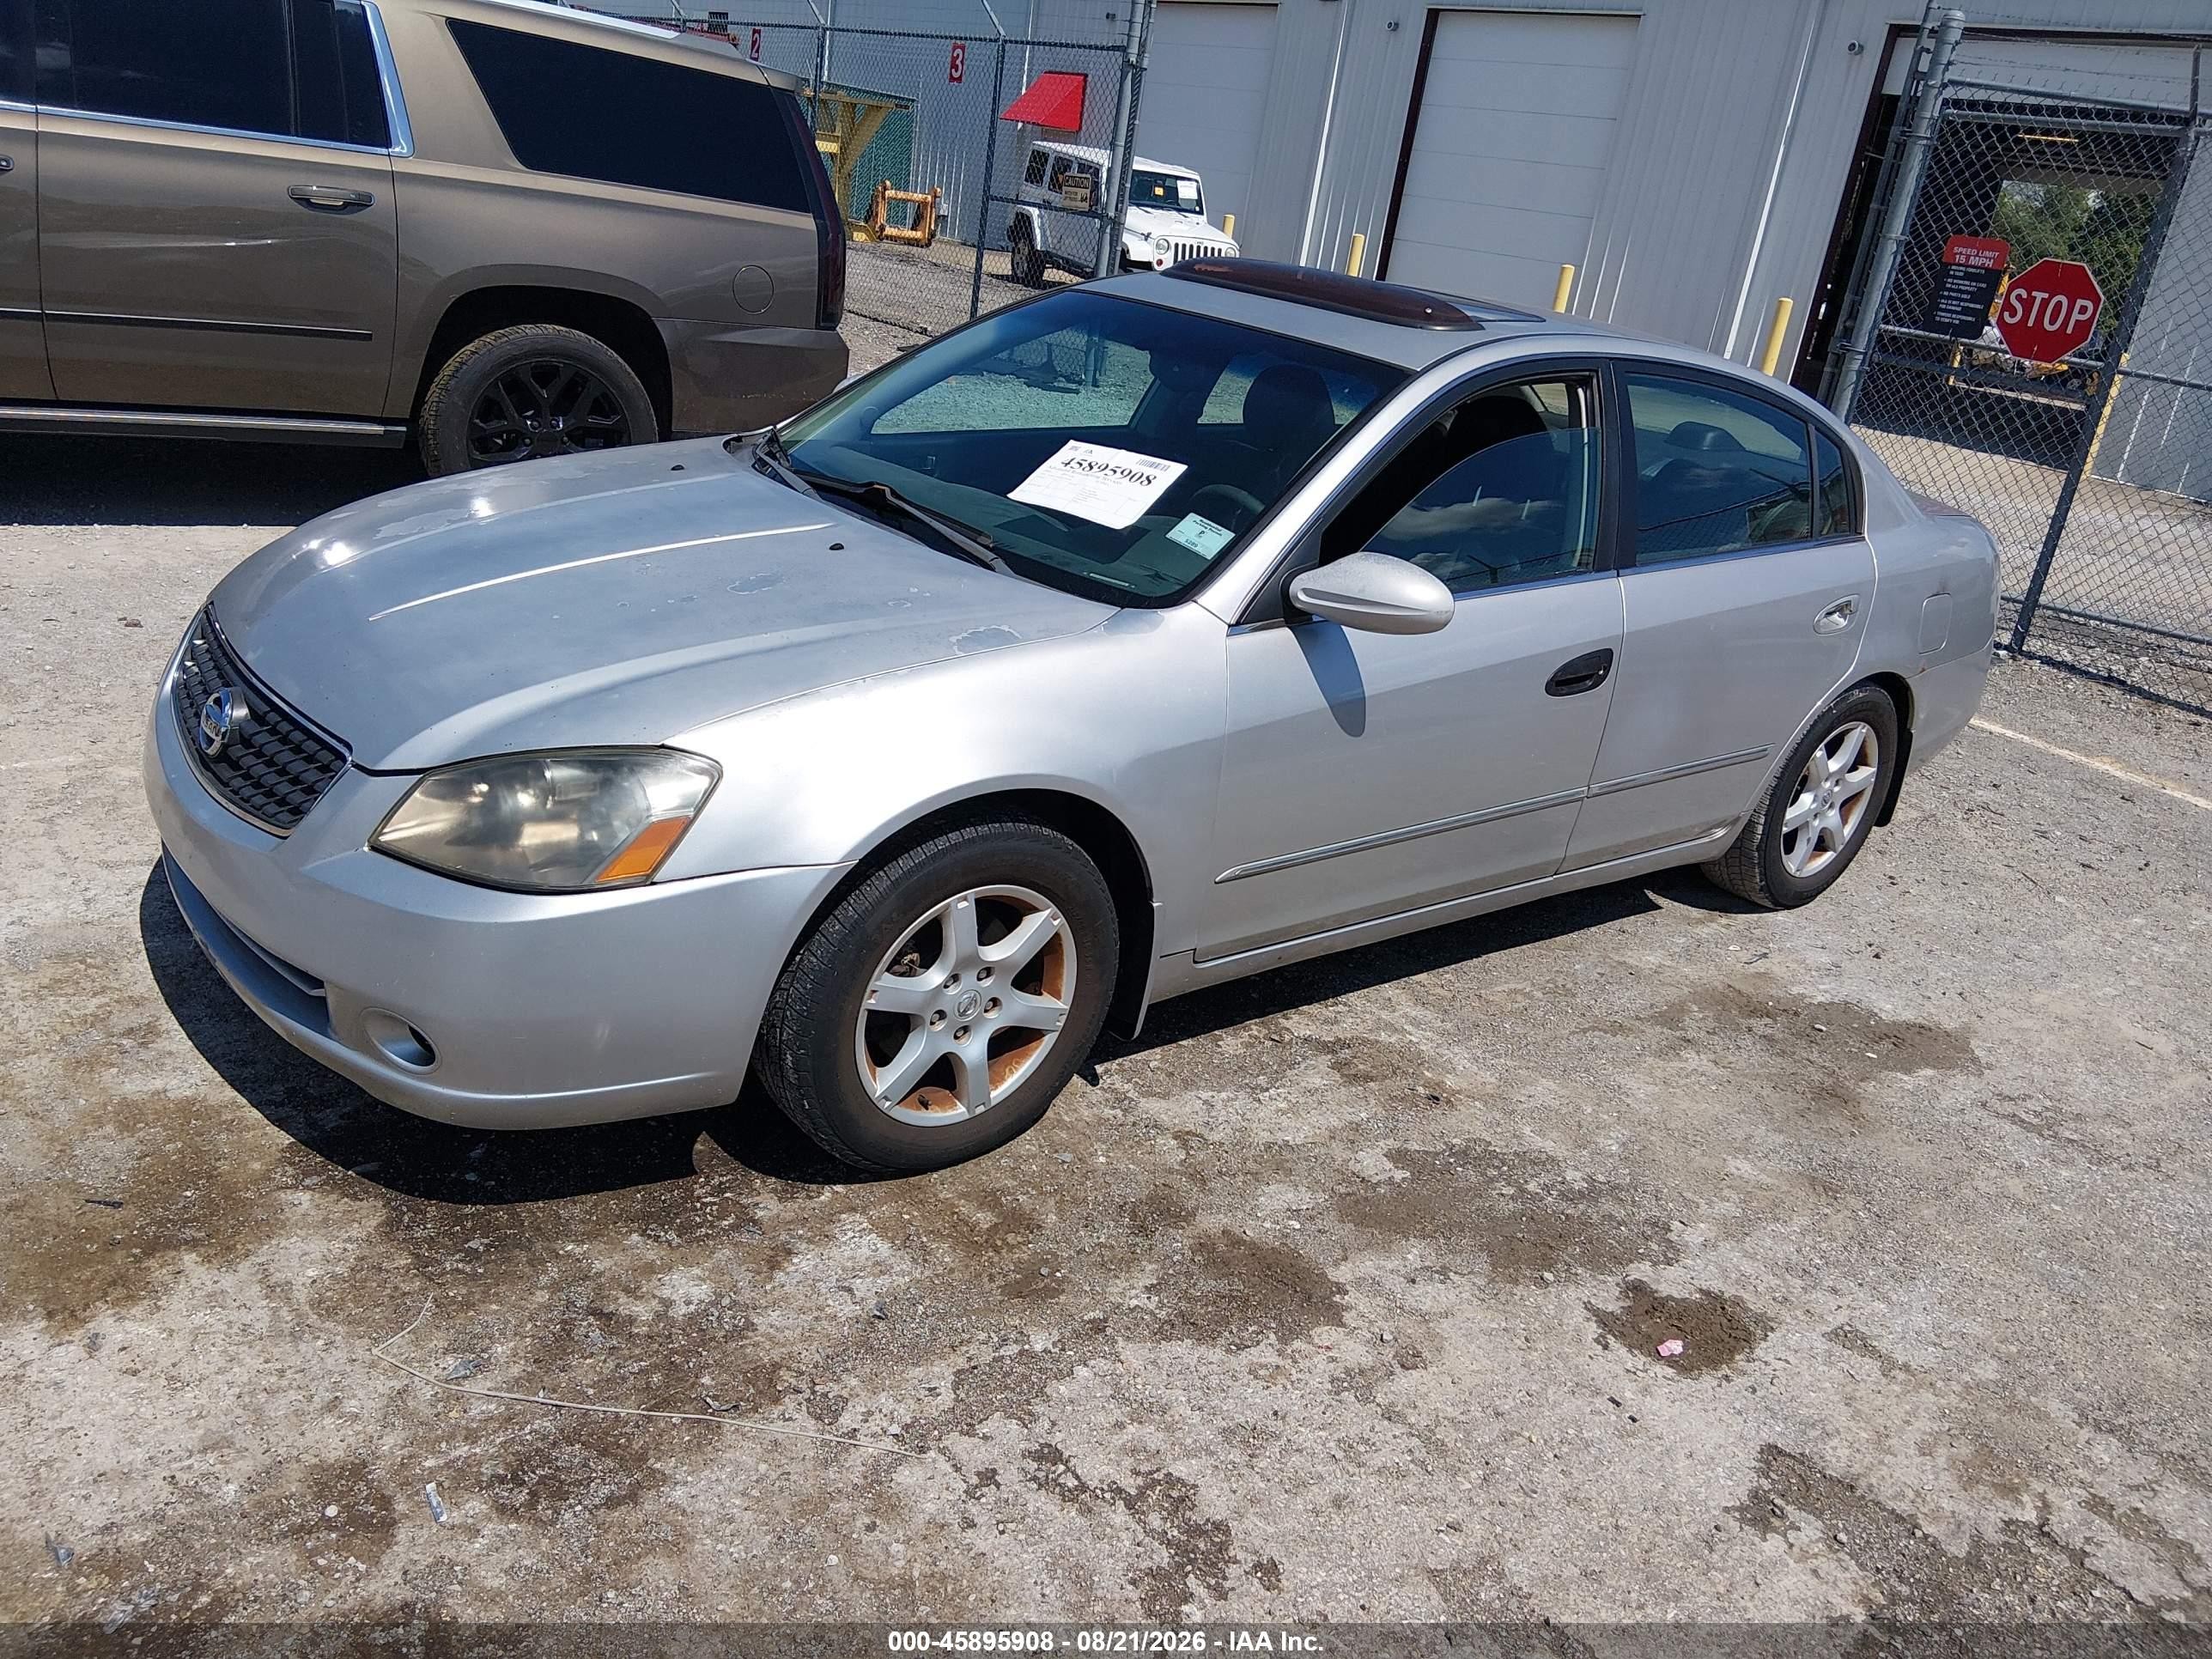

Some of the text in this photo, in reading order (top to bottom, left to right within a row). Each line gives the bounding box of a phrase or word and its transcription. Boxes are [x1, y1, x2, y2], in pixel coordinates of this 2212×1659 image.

[750, 33, 760, 58] 2
[951, 48, 963, 77] 3
[1065, 176, 1090, 188] CAUTION
[1953, 246, 2000, 259] SPEED LIMIT
[1954, 254, 1994, 267] 15 MPH
[2003, 288, 2094, 334] STOP
[1060, 457, 1158, 487] 45895908
